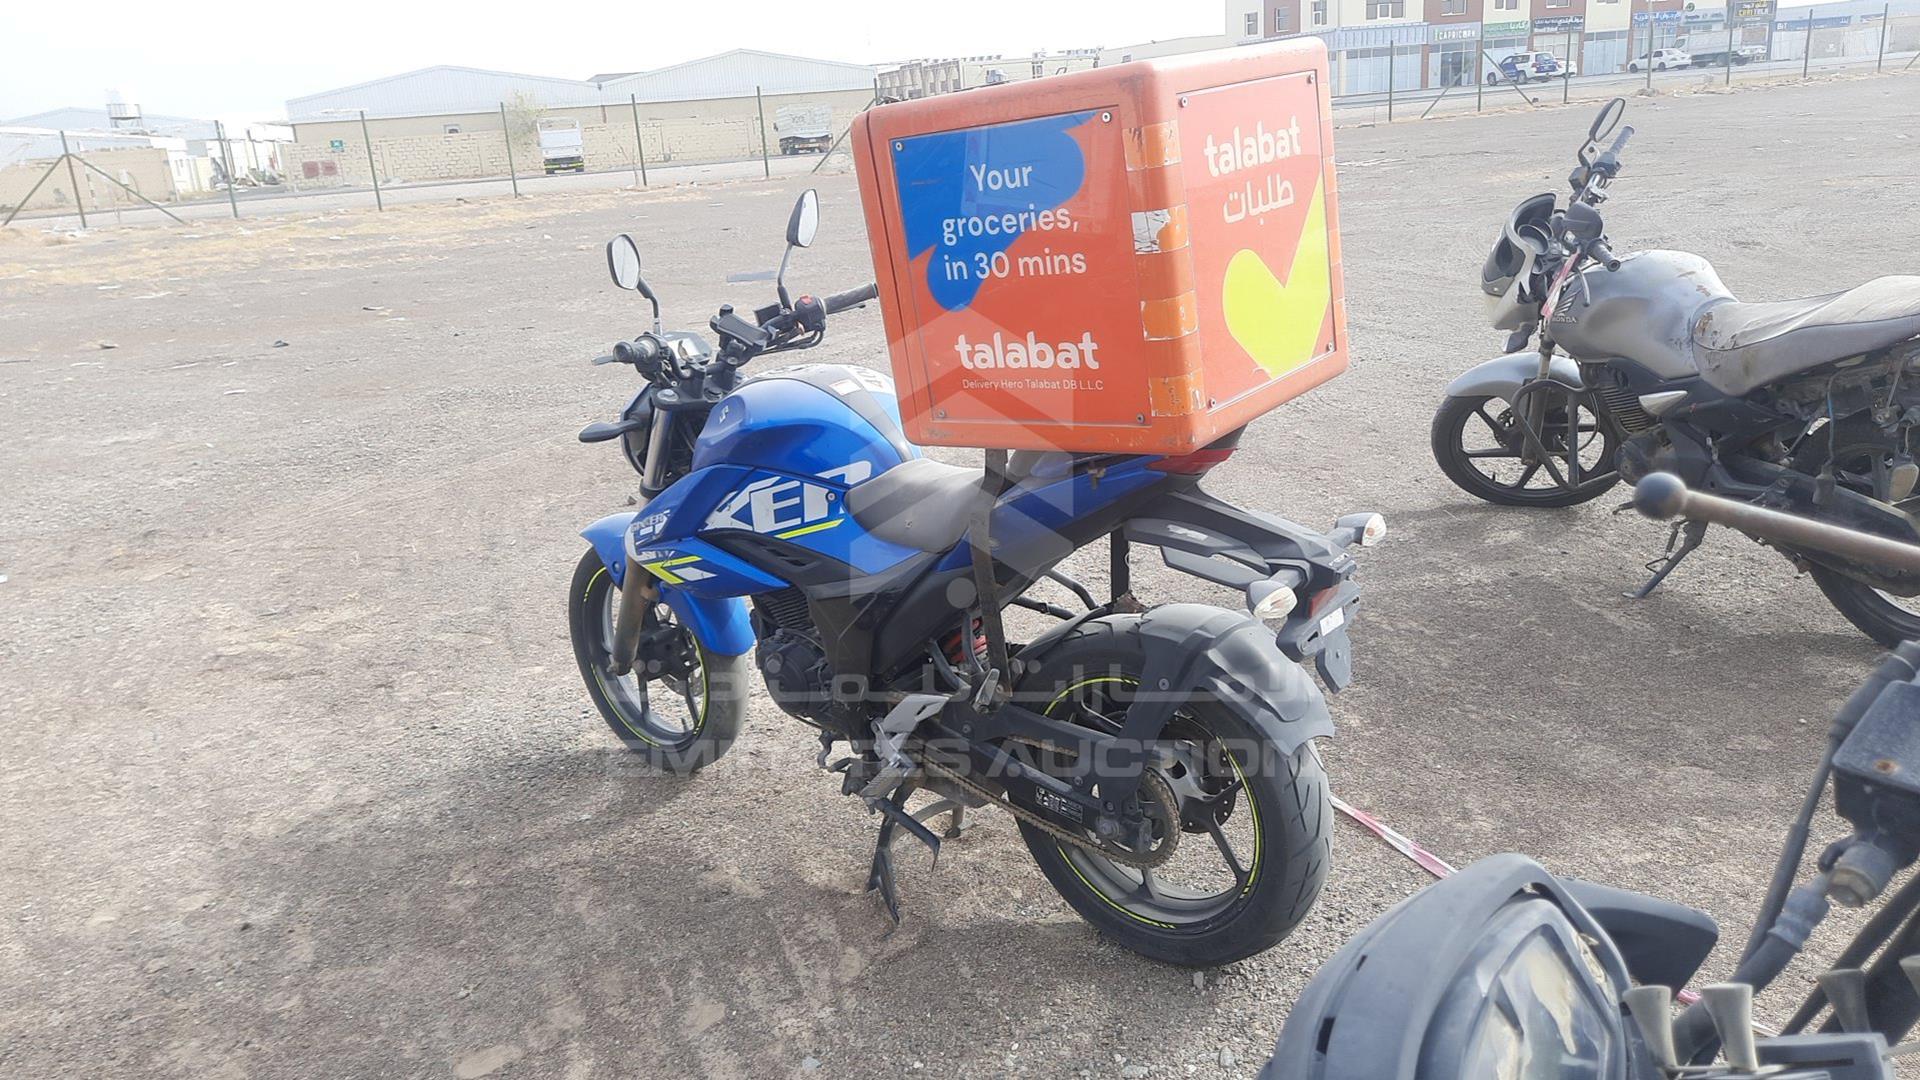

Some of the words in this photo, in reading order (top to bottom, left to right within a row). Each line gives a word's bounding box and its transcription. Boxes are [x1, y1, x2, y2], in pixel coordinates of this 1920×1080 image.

[1203, 115, 1301, 177] talabat
[970, 163, 1033, 192] Your
[1223, 173, 1295, 225] طلبات
[942, 203, 1079, 246] groceries,
[943, 254, 968, 281] in
[974, 251, 1010, 279] 30
[1018, 247, 1087, 277] mins
[954, 330, 1100, 370] talabat
[962, 379, 999, 391] Delivery
[1001, 379, 1024, 389] Hero
[1025, 379, 1060, 389] Talabat
[1063, 379, 1077, 390] DB
